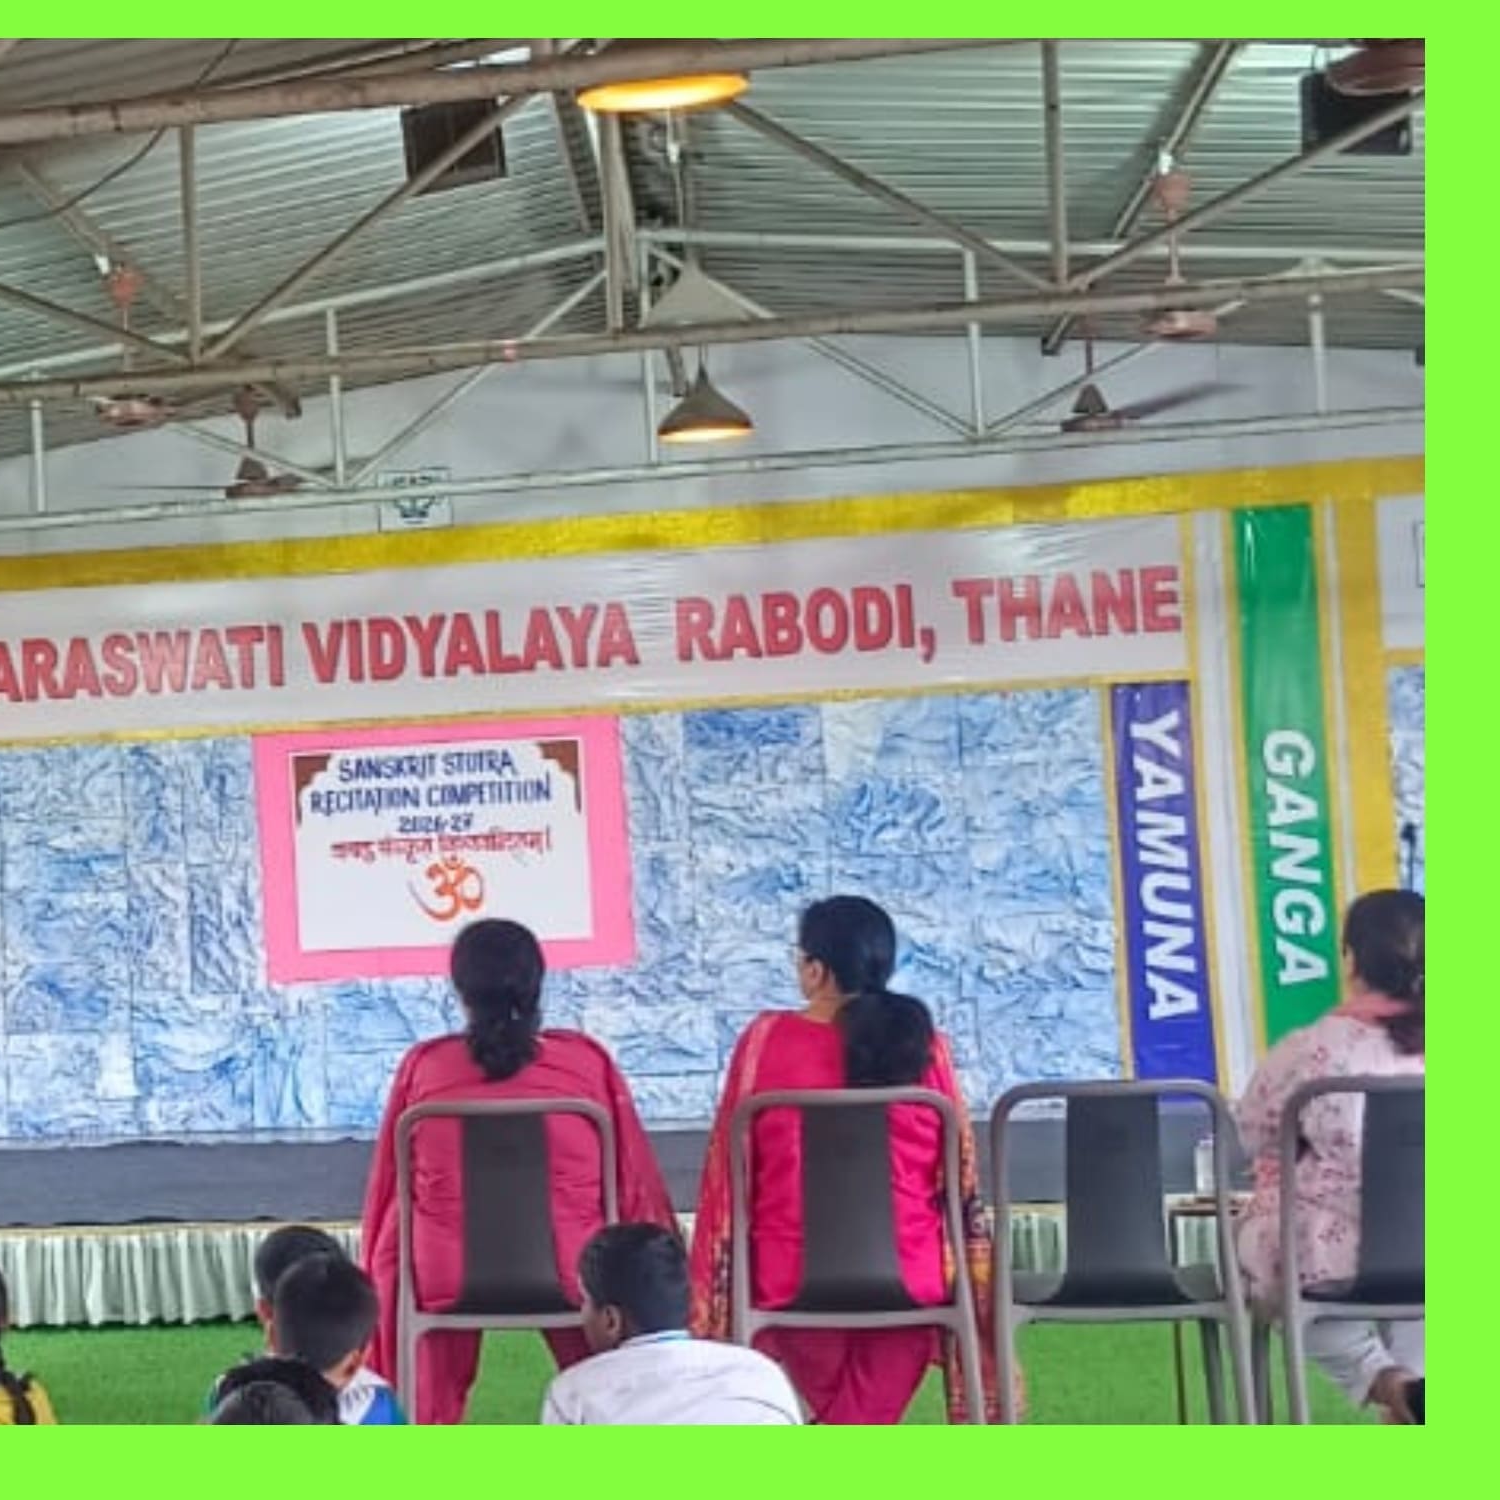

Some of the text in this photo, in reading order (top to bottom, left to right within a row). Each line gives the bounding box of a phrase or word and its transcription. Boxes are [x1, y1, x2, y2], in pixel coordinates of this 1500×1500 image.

[301, 602, 640, 684] VIDYALAYA
[675, 583, 937, 664] RABODI,
[951, 564, 1183, 645] THANE
[310, 771, 551, 817] RECITATION COMPETITION
[338, 753, 436, 783] SANSKRIT
[1129, 709, 1200, 1021] YAMUNA
[1262, 728, 1330, 987] GANGA
